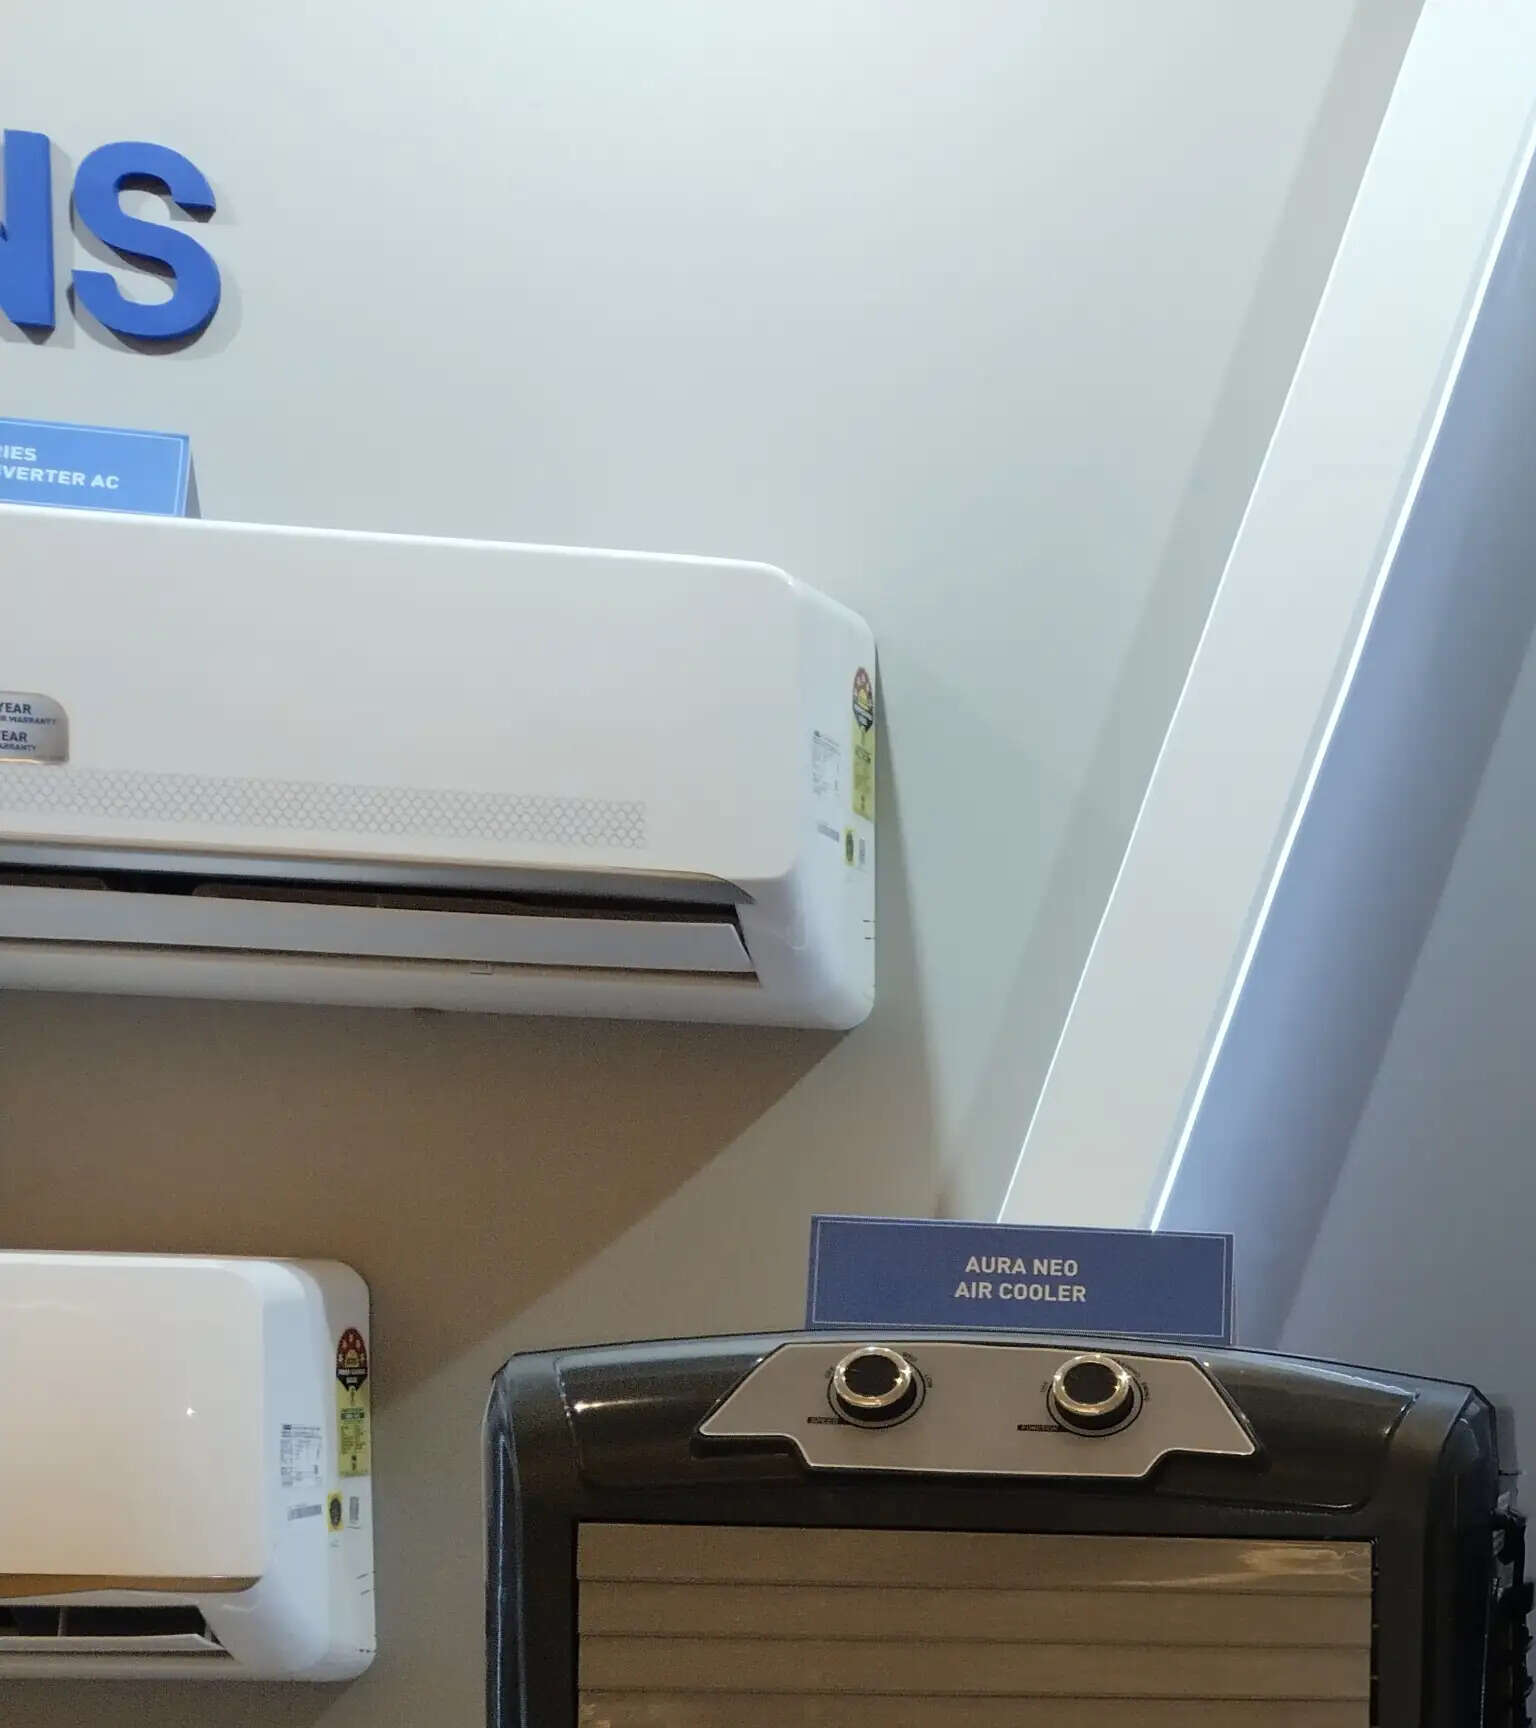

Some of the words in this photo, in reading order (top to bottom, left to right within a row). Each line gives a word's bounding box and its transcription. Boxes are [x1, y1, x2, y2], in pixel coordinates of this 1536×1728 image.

[0, 445, 37, 461] IES
[0, 465, 85, 486] VERTER
[91, 475, 120, 489] AC
[0, 730, 28, 743] EAR
[965, 1256, 1027, 1275] AURA
[1033, 1259, 1078, 1276] NEO
[954, 1281, 992, 1299] AIR
[999, 1283, 1087, 1302] COOLER
